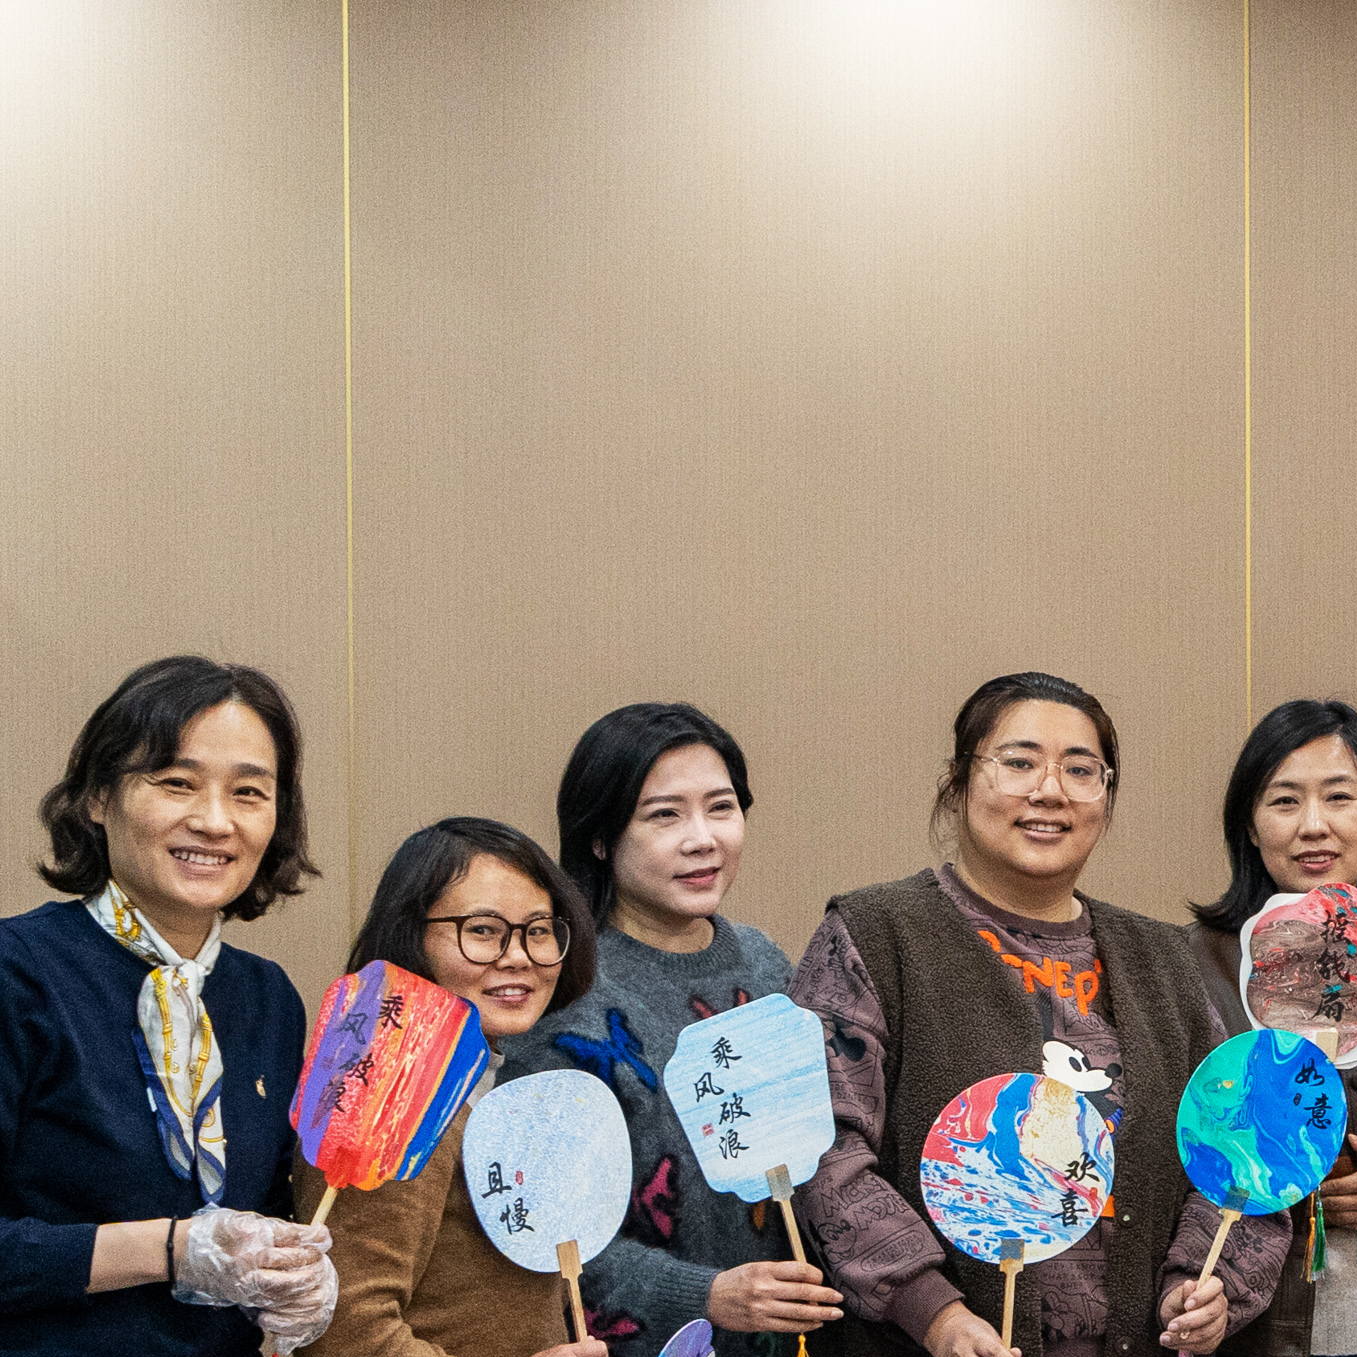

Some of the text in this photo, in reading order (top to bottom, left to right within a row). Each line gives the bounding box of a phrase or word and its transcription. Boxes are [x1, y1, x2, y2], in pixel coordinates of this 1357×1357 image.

[319, 994, 403, 1114] 乘风破浪
[693, 1035, 751, 1160] 乘风破浪
[1294, 1058, 1333, 1130] 如意
[481, 1162, 534, 1235] 且慢
[1050, 1152, 1100, 1227] 欢喜
